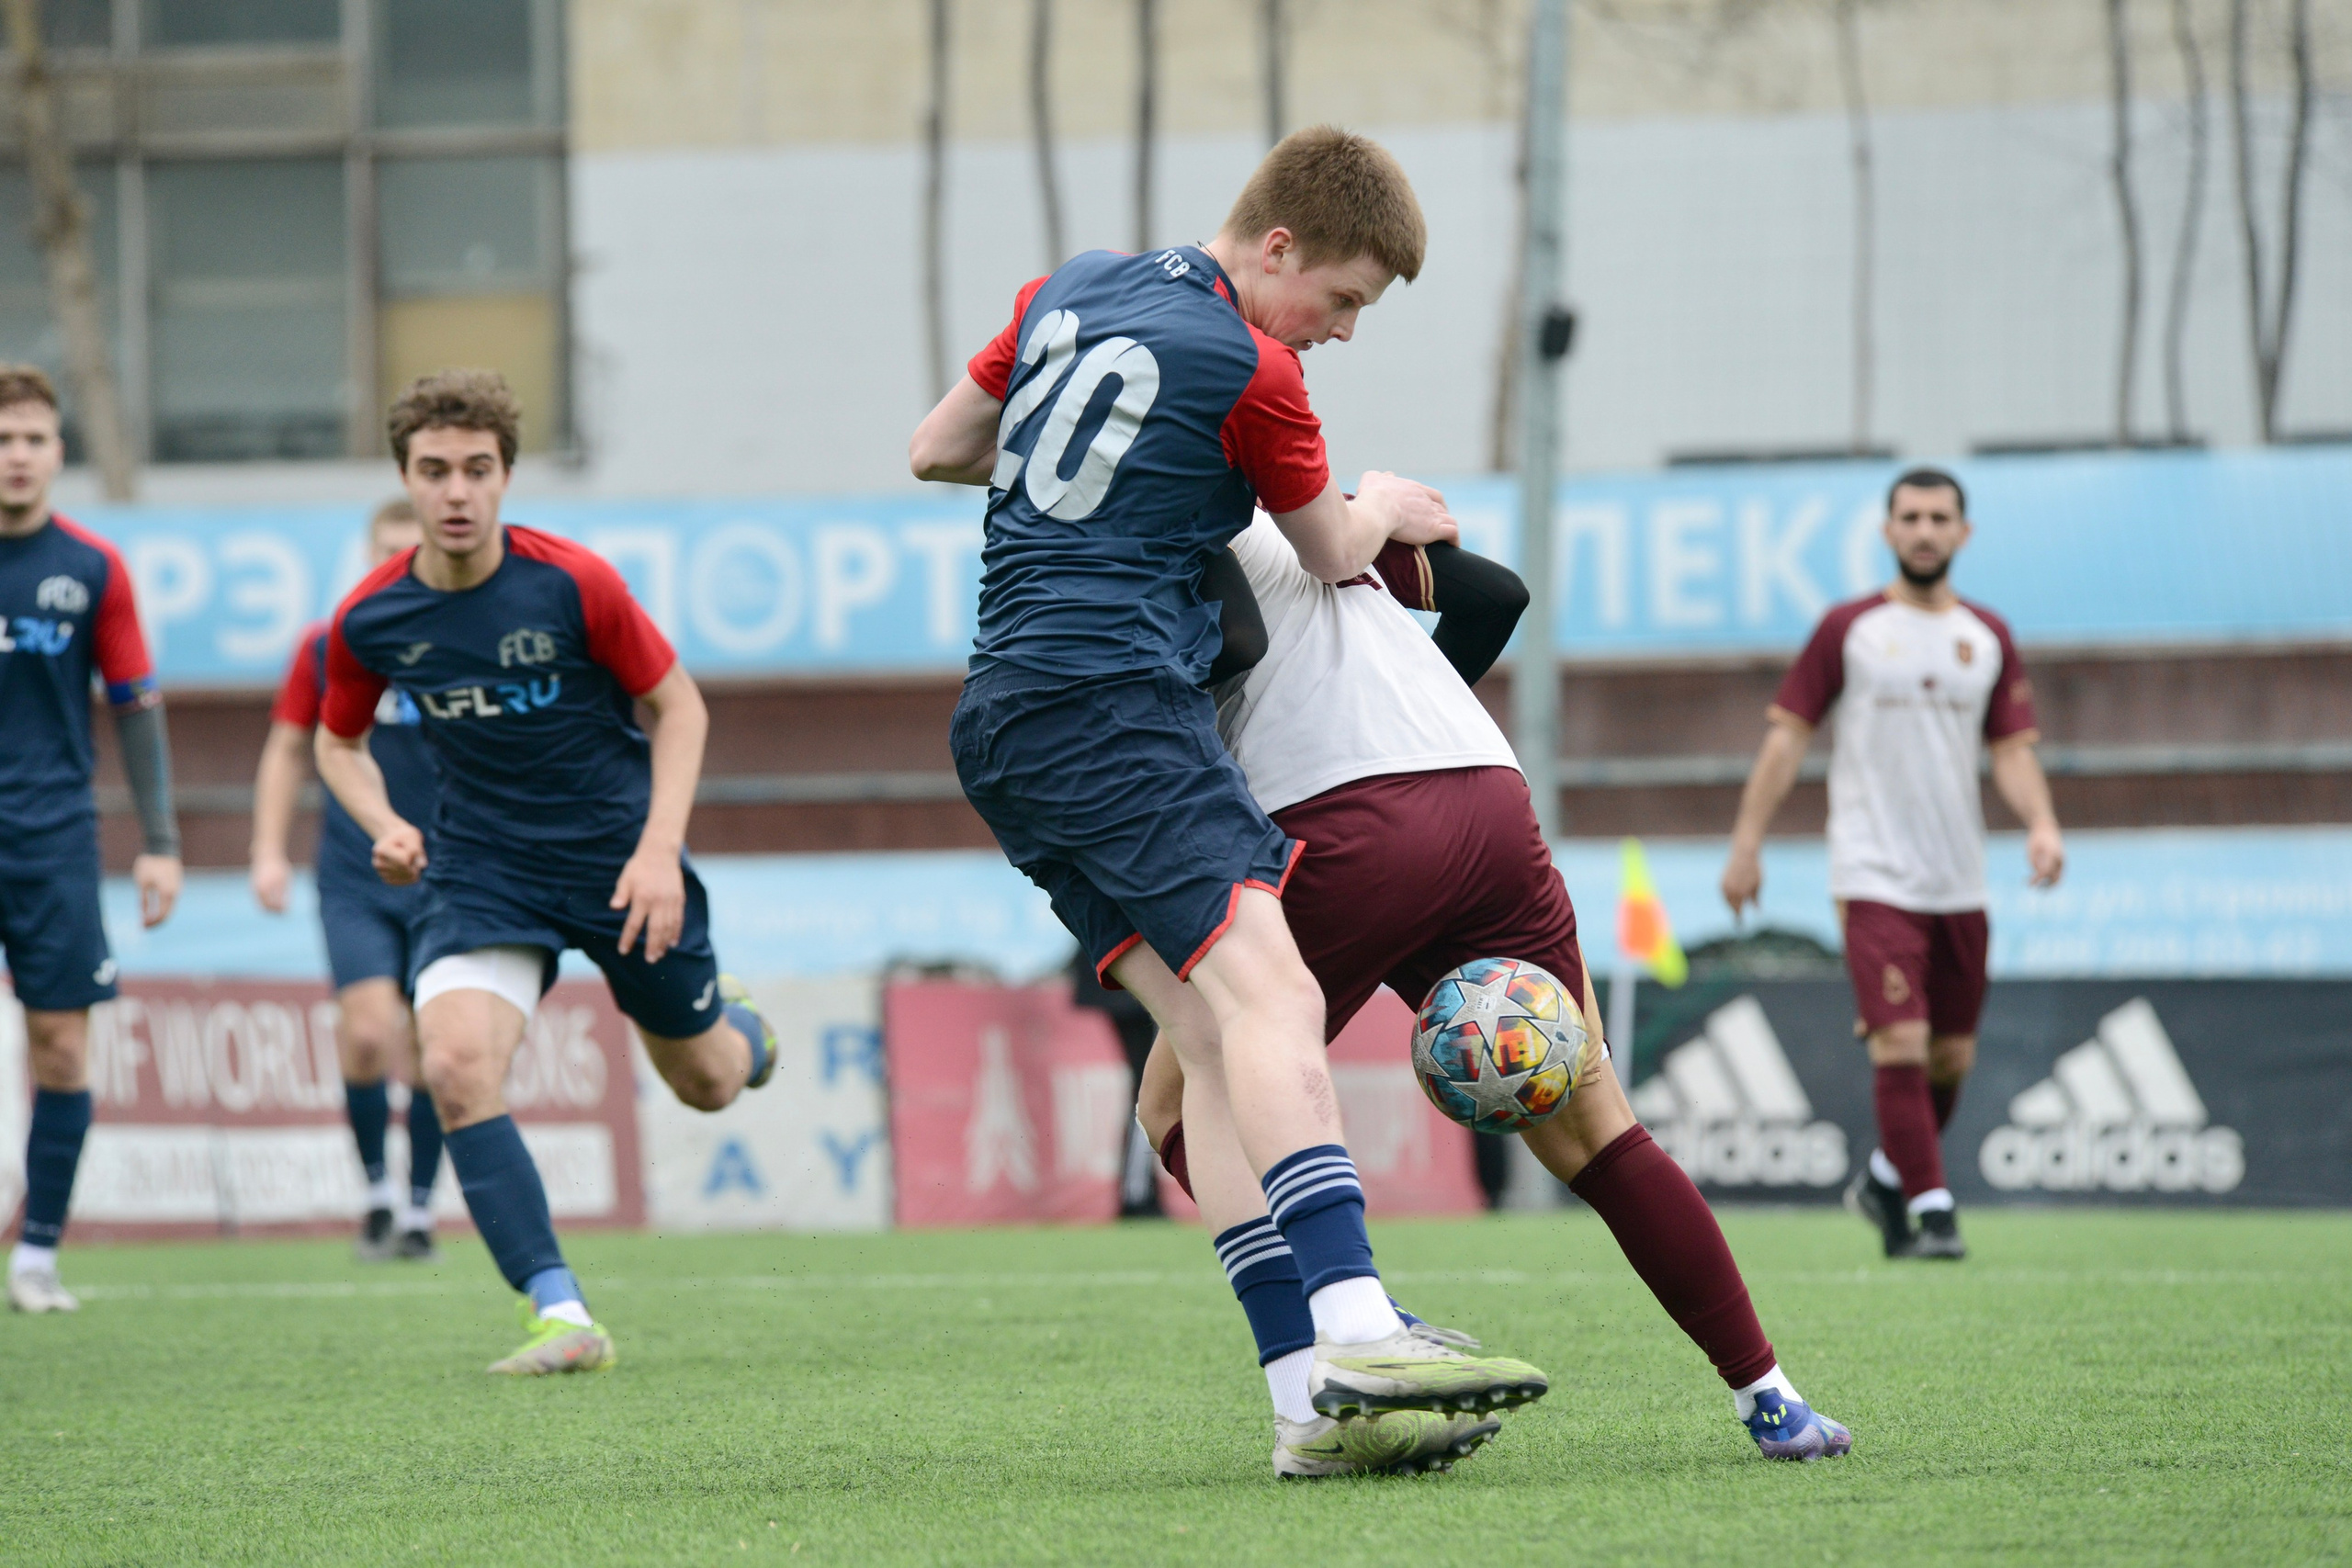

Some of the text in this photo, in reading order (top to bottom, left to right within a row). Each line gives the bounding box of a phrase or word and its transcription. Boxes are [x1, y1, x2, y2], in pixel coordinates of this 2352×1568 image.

[1155, 249, 1191, 278] FCB
[989, 308, 1160, 521] 20
[498, 627, 558, 669] FCB
[1638, 1117, 1850, 1188] didas
[1977, 1118, 2246, 1194] adidas
